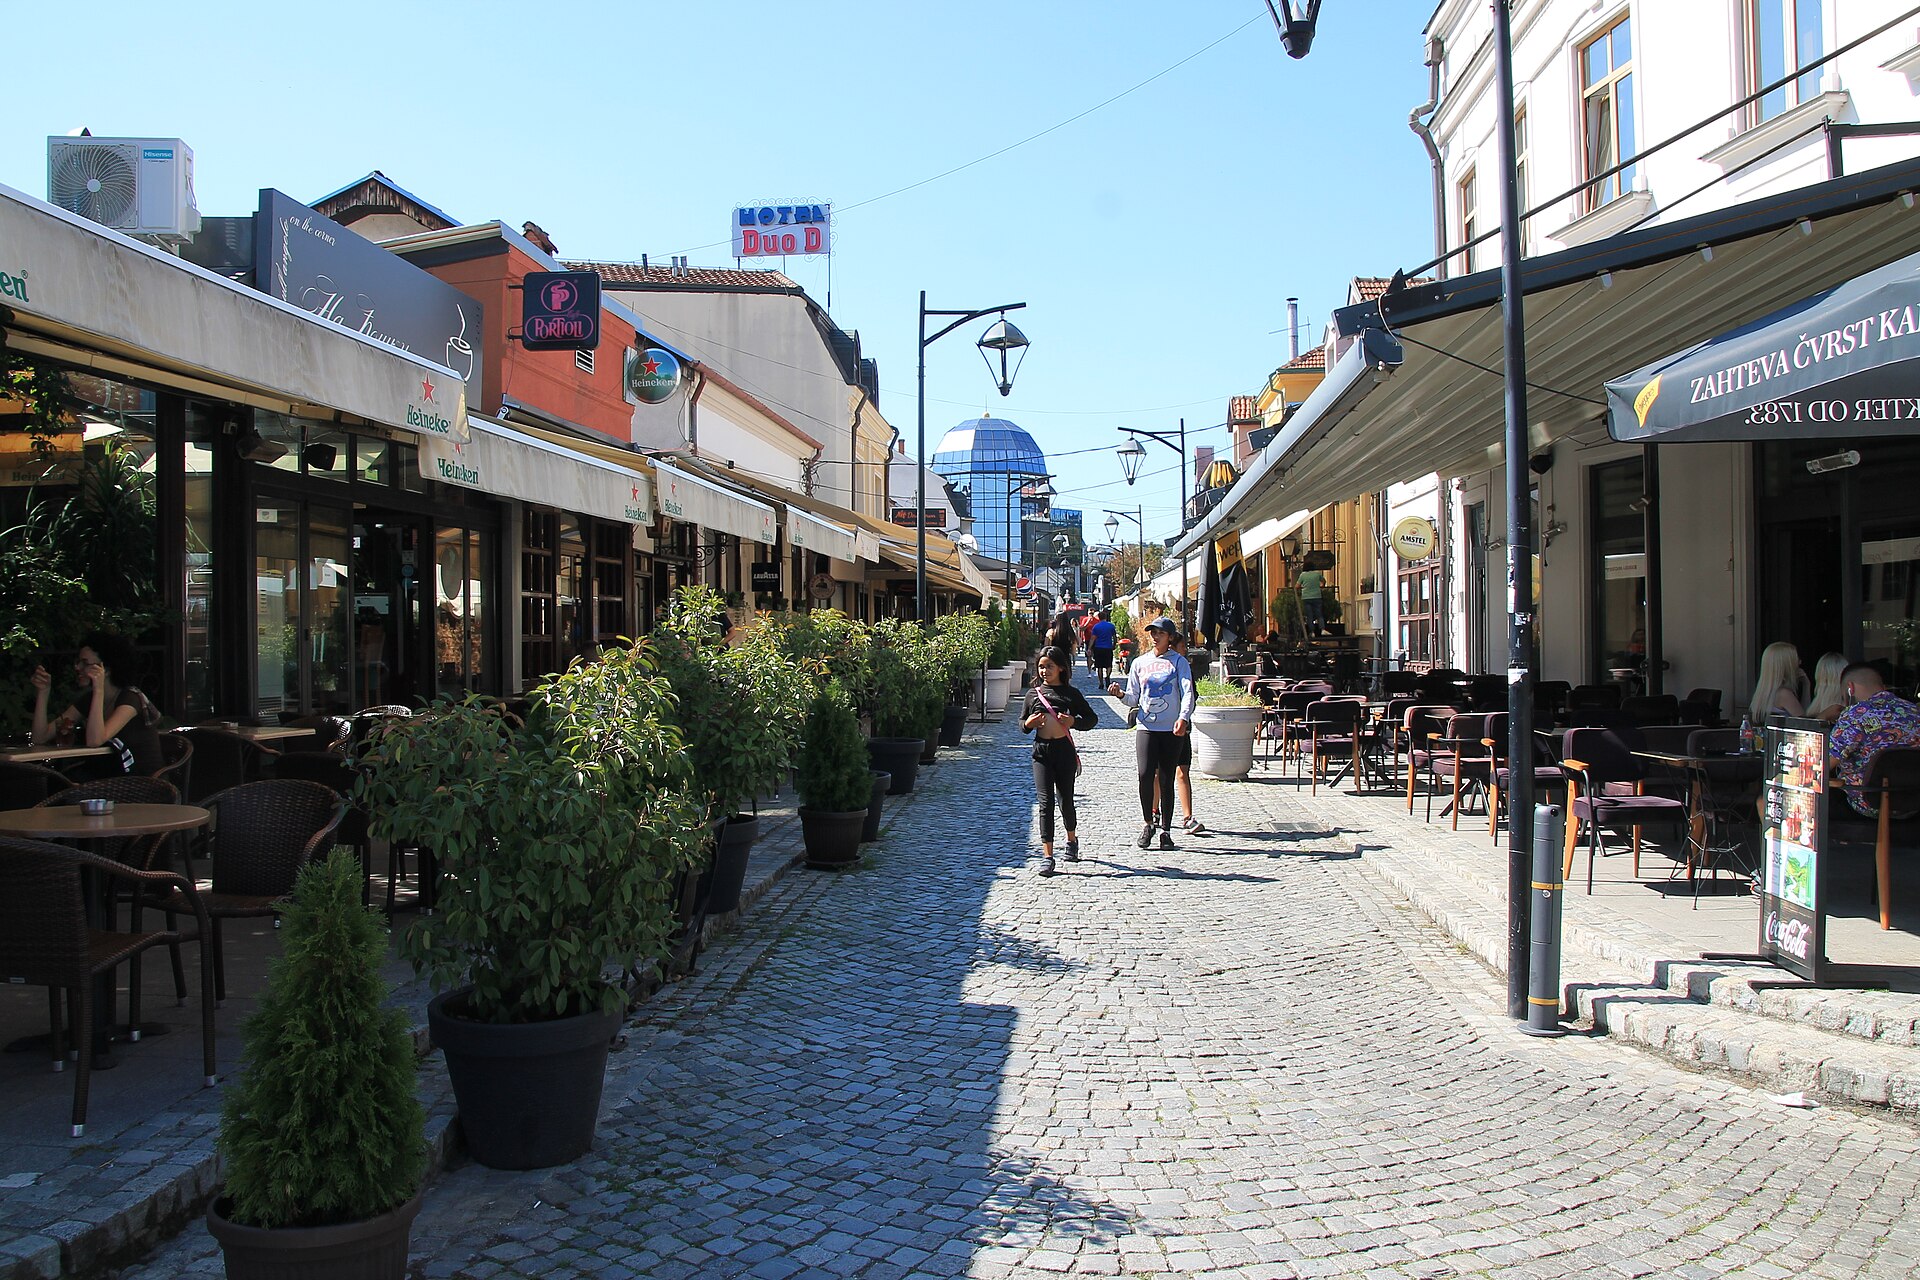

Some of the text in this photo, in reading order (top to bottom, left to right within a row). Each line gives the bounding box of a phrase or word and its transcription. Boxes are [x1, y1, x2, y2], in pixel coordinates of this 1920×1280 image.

[289, 216, 337, 247] on the corner
[743, 226, 821, 254] Duo D
[1690, 348, 1788, 404] ZAHTEVA
[1793, 316, 1874, 371] ČVRST
[1877, 303, 1920, 342] KA
[632, 379, 674, 388] Heineken
[407, 404, 452, 434] Heineke
[1400, 534, 1427, 545] AMSTEL
